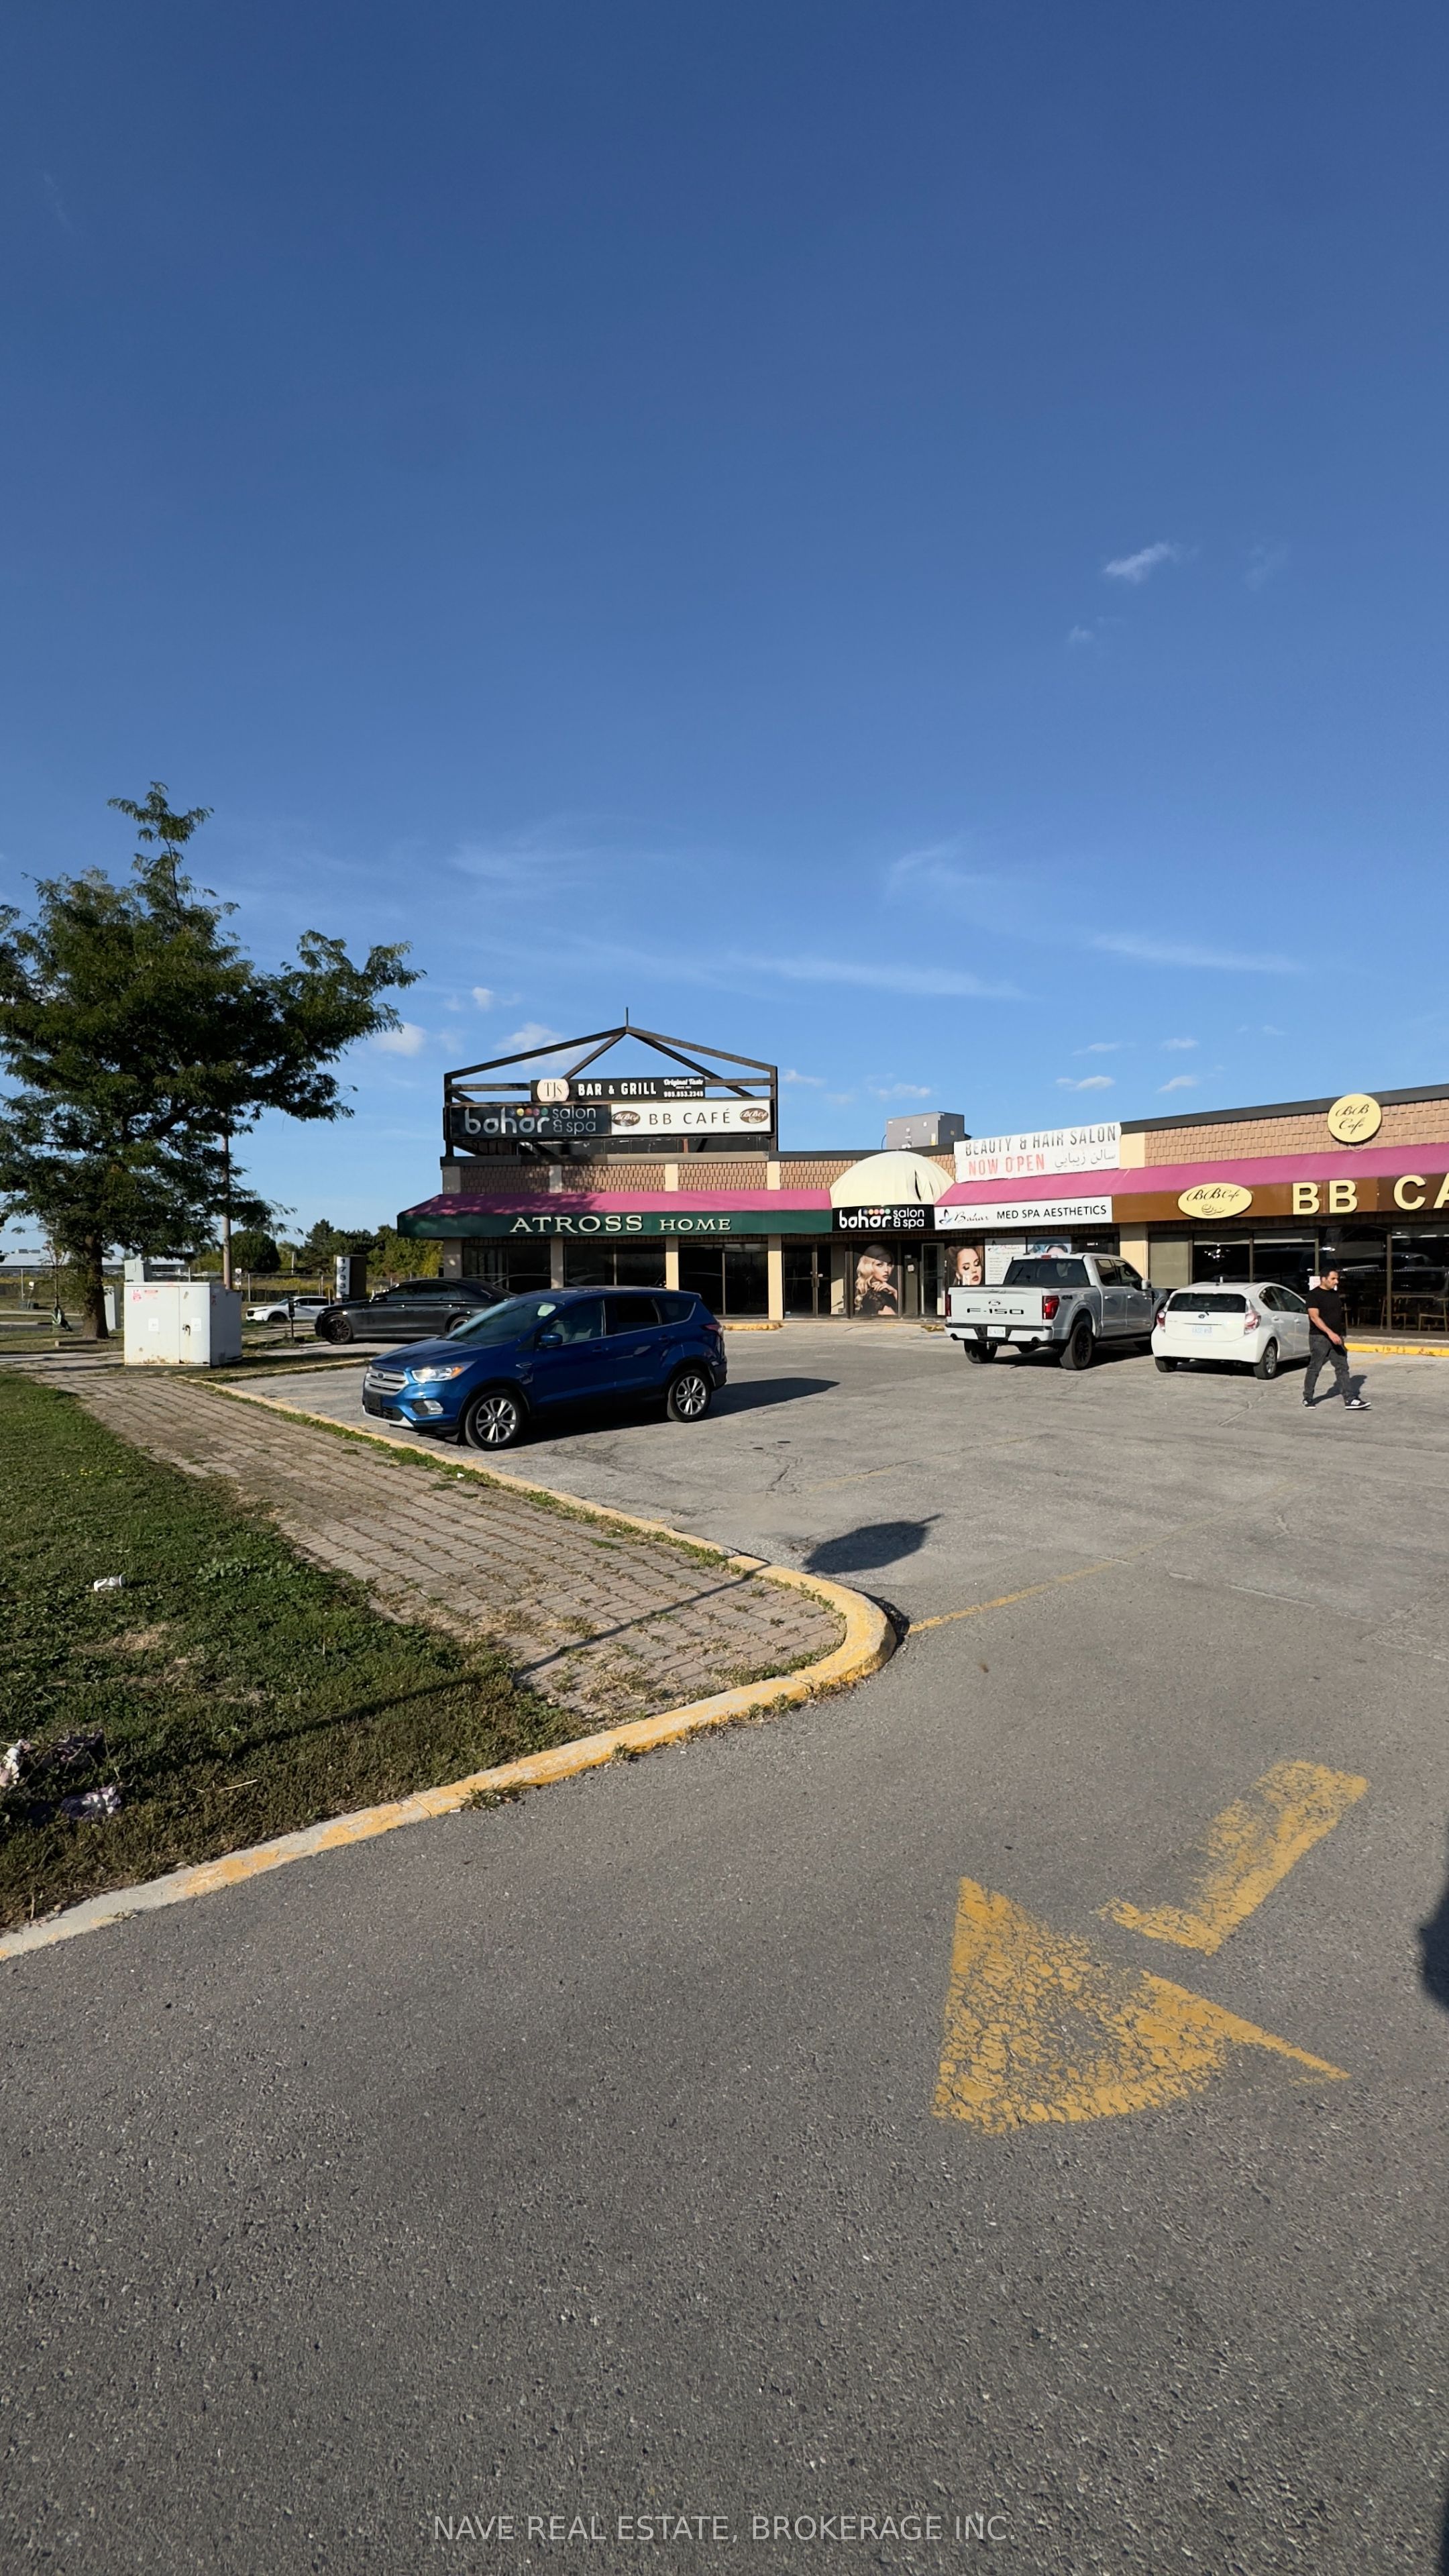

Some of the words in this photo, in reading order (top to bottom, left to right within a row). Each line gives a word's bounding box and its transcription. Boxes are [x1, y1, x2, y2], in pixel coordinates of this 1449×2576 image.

[578, 1083, 602, 1095] BAR
[608, 1085, 614, 1095] &
[621, 1083, 657, 1095] GRILL
[465, 1107, 550, 1134] bahar
[553, 1106, 596, 1119] salon
[649, 1114, 672, 1125] BB
[683, 1108, 731, 1124] CAFÉ
[553, 1119, 562, 1132] &
[566, 1121, 596, 1134] spa
[965, 1137, 1011, 1157] BEAUTY
[1020, 1136, 1026, 1150] &
[1033, 1133, 1064, 1148] HAIR
[1070, 1125, 1116, 1145] SALON
[969, 1159, 998, 1176] NOW
[1006, 1154, 1044, 1172] OPEN
[1293, 1179, 1358, 1215] BB
[839, 1209, 892, 1229] bahar
[893, 1208, 924, 1218] salon
[997, 1210, 1018, 1220] MED
[1022, 1209, 1040, 1218] SPA
[1044, 1205, 1107, 1218] AESTHETICS
[510, 1215, 642, 1233] ATROSS
[659, 1218, 731, 1231] HOME
[893, 1218, 900, 1228] &
[903, 1219, 924, 1229] spa
